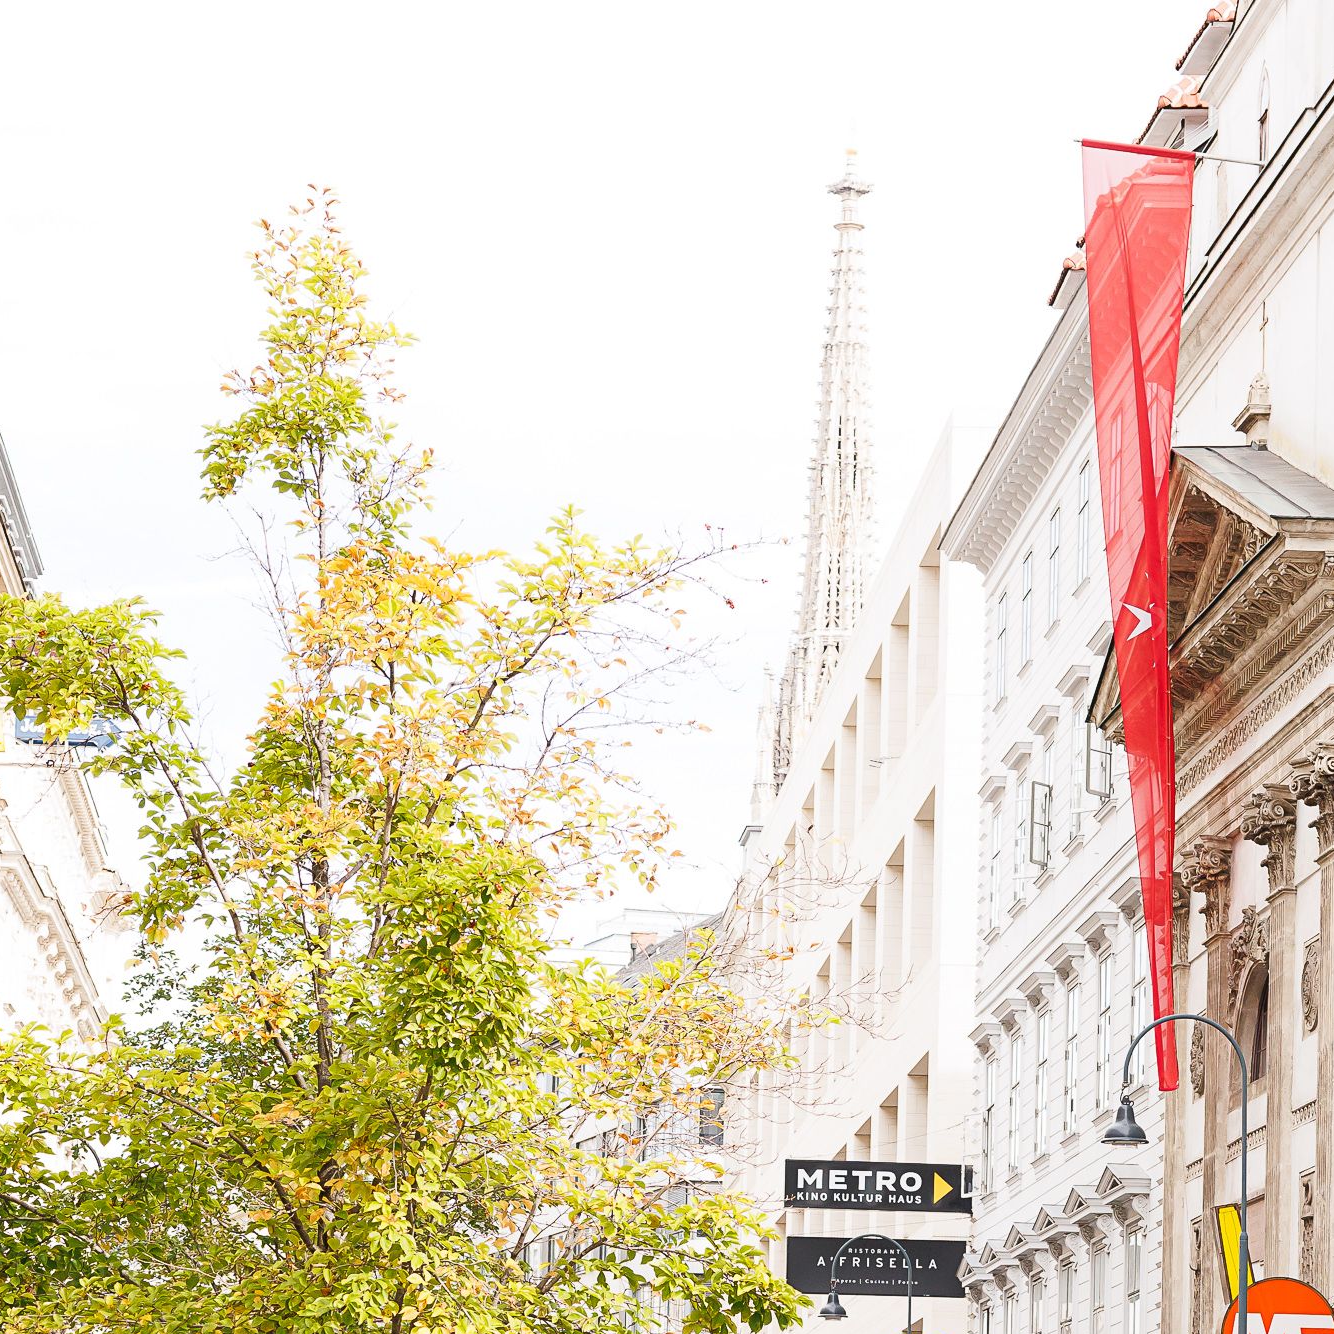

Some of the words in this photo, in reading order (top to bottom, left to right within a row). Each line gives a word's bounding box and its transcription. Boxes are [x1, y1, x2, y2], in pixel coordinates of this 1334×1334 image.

[797, 1168, 923, 1192] METRO
[796, 1192, 828, 1202] KINO
[833, 1192, 883, 1203] KULTUR
[888, 1194, 922, 1204] HAUS
